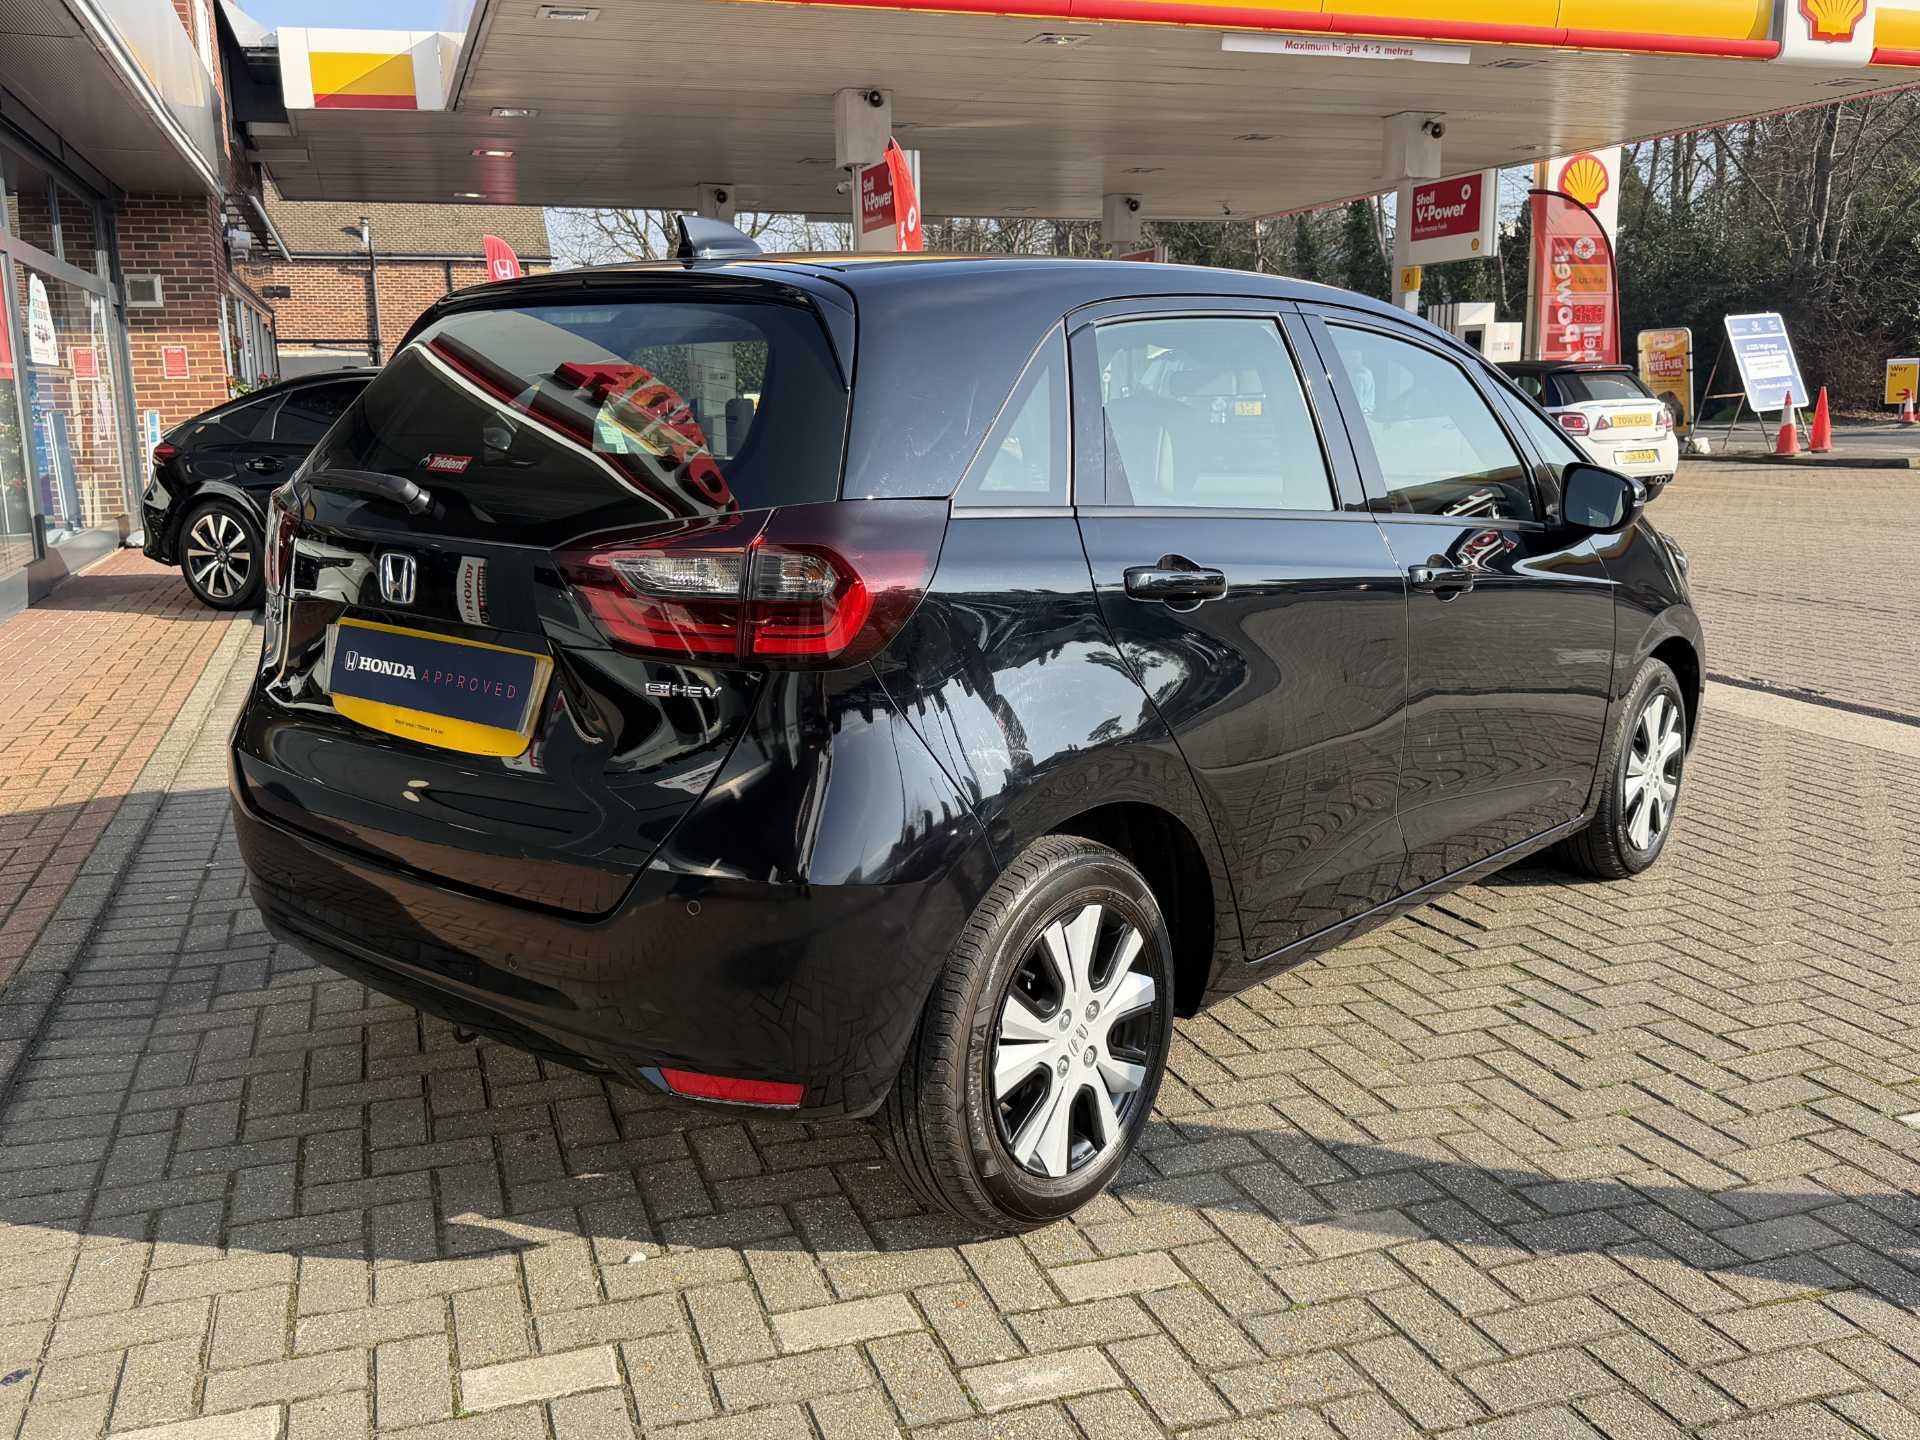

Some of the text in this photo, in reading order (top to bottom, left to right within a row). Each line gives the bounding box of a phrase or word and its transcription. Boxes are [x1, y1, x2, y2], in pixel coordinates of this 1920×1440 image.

[1284, 39, 1331, 52] Maximum
[1332, 43, 1360, 55] height
[1384, 46, 1414, 57] metres
[863, 175, 875, 193] Shell
[864, 190, 893, 212] V-Power
[1416, 190, 1435, 206] Shell
[1416, 203, 1467, 223] V-Power
[1403, 272, 1411, 287] 4
[1650, 351, 1666, 361] Win
[1665, 358, 1683, 370] FUEL
[430, 456, 468, 470] Trident
[358, 656, 517, 699] HONDA APPROVED
